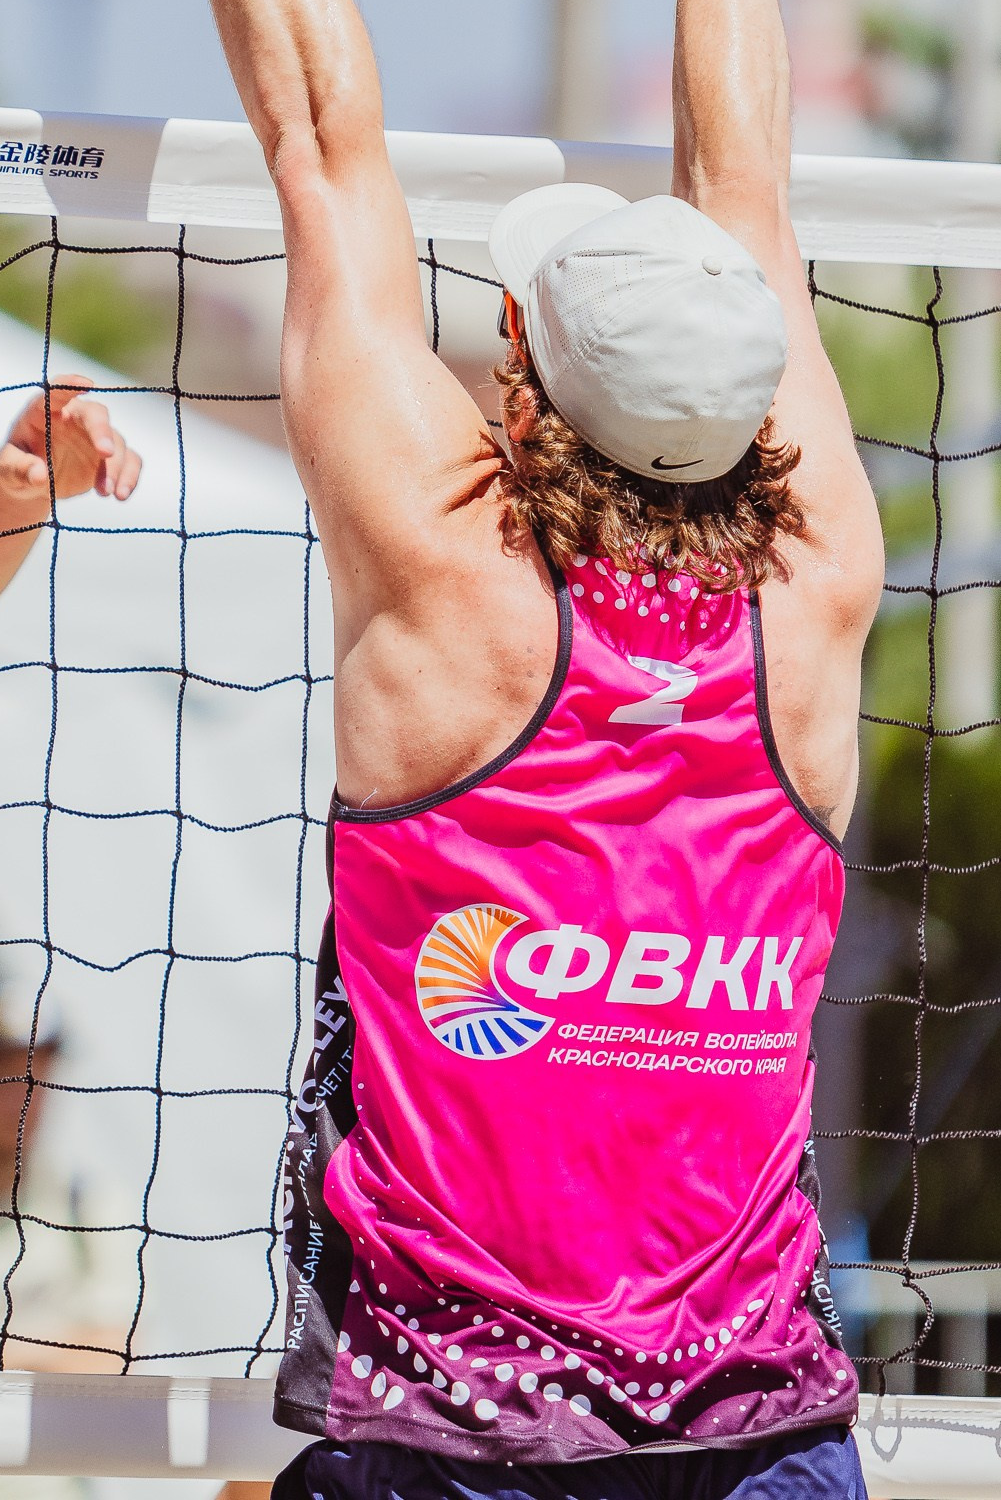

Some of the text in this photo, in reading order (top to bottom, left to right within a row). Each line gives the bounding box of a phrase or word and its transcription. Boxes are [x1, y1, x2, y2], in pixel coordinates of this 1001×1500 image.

[49, 169, 99, 180] SPORTS
[608, 655, 698, 726] 2
[505, 923, 804, 1011] ФВКК
[557, 1023, 798, 1050] ФЕДЕРАЦИЯ ВОЛЕЙБОЛА
[547, 1048, 787, 1075] КРАСНОДАРСКОГО КРАЯ
[287, 1219, 324, 1350] РАСПИСАНИЕ
